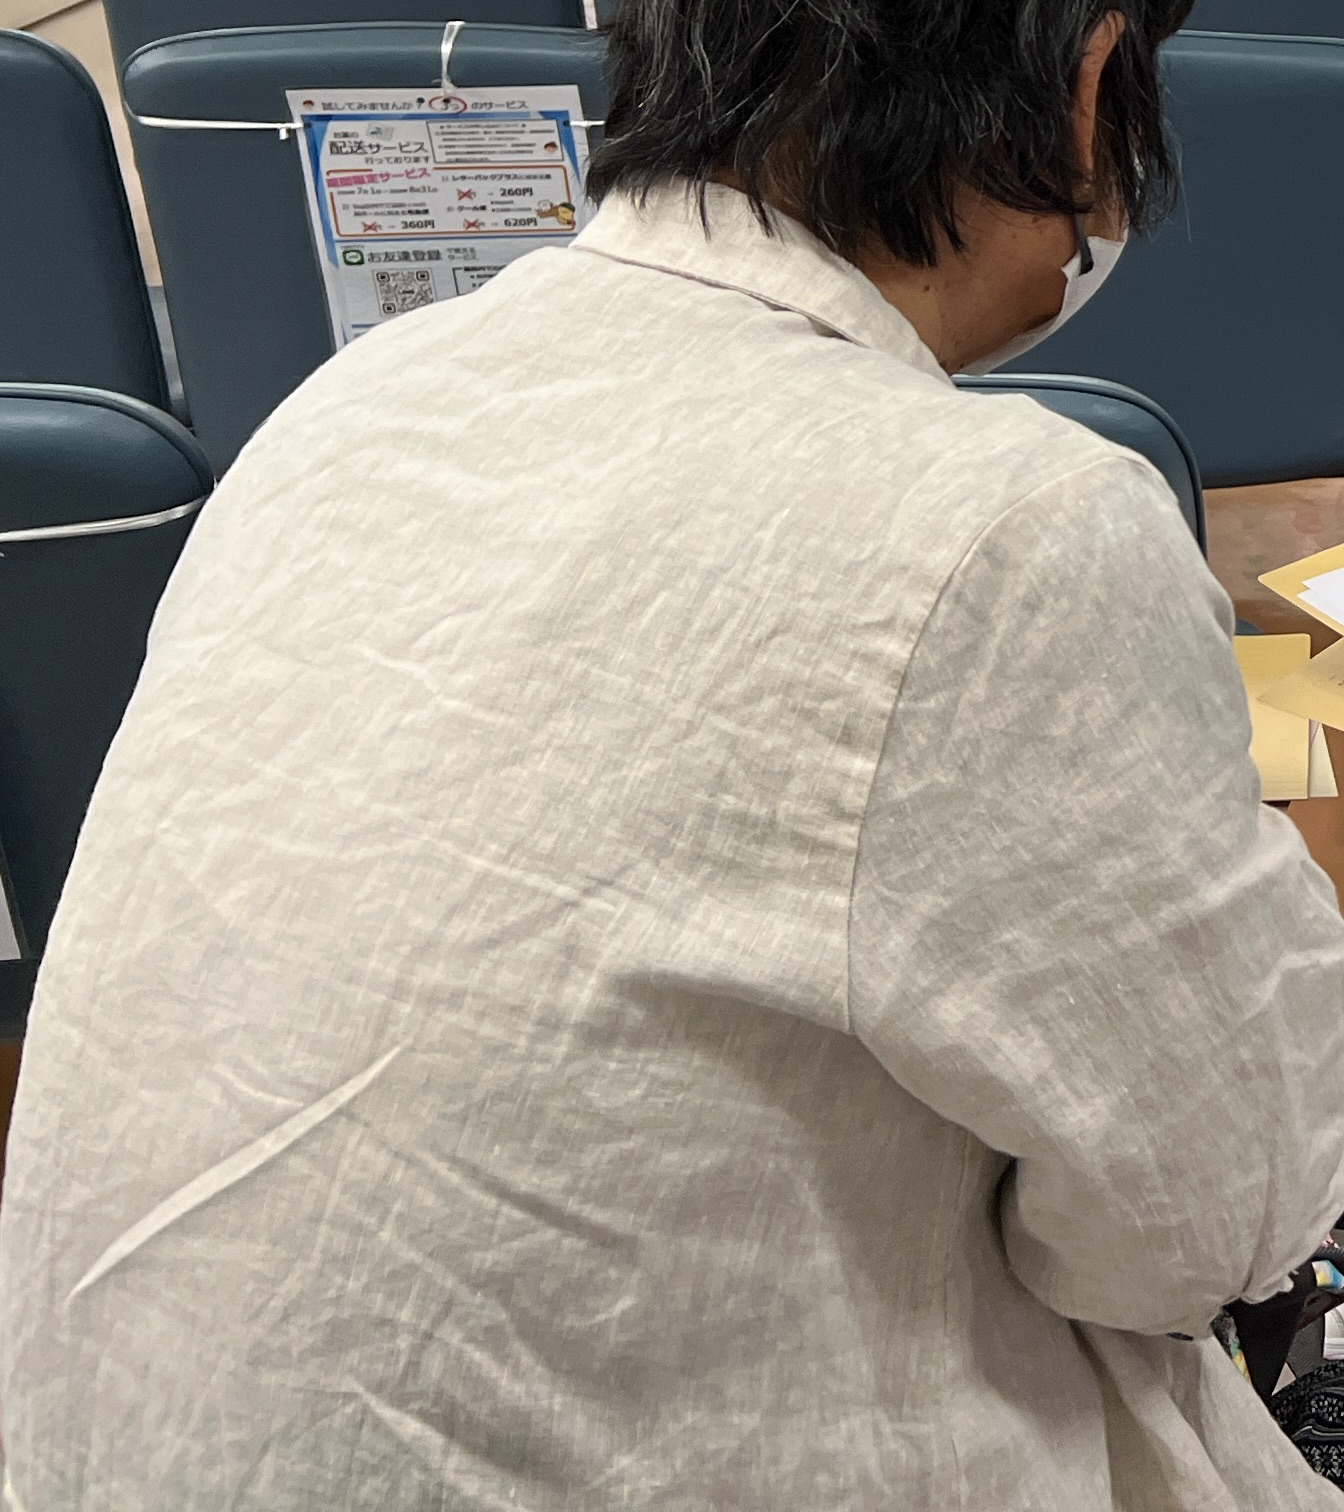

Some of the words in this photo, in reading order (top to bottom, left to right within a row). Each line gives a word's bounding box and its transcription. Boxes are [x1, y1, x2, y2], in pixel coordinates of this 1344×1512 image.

[329, 141, 428, 155] 配送サービス
[500, 188, 534, 197] 260円
[401, 220, 435, 229] 360円
[504, 218, 538, 227] 620円
